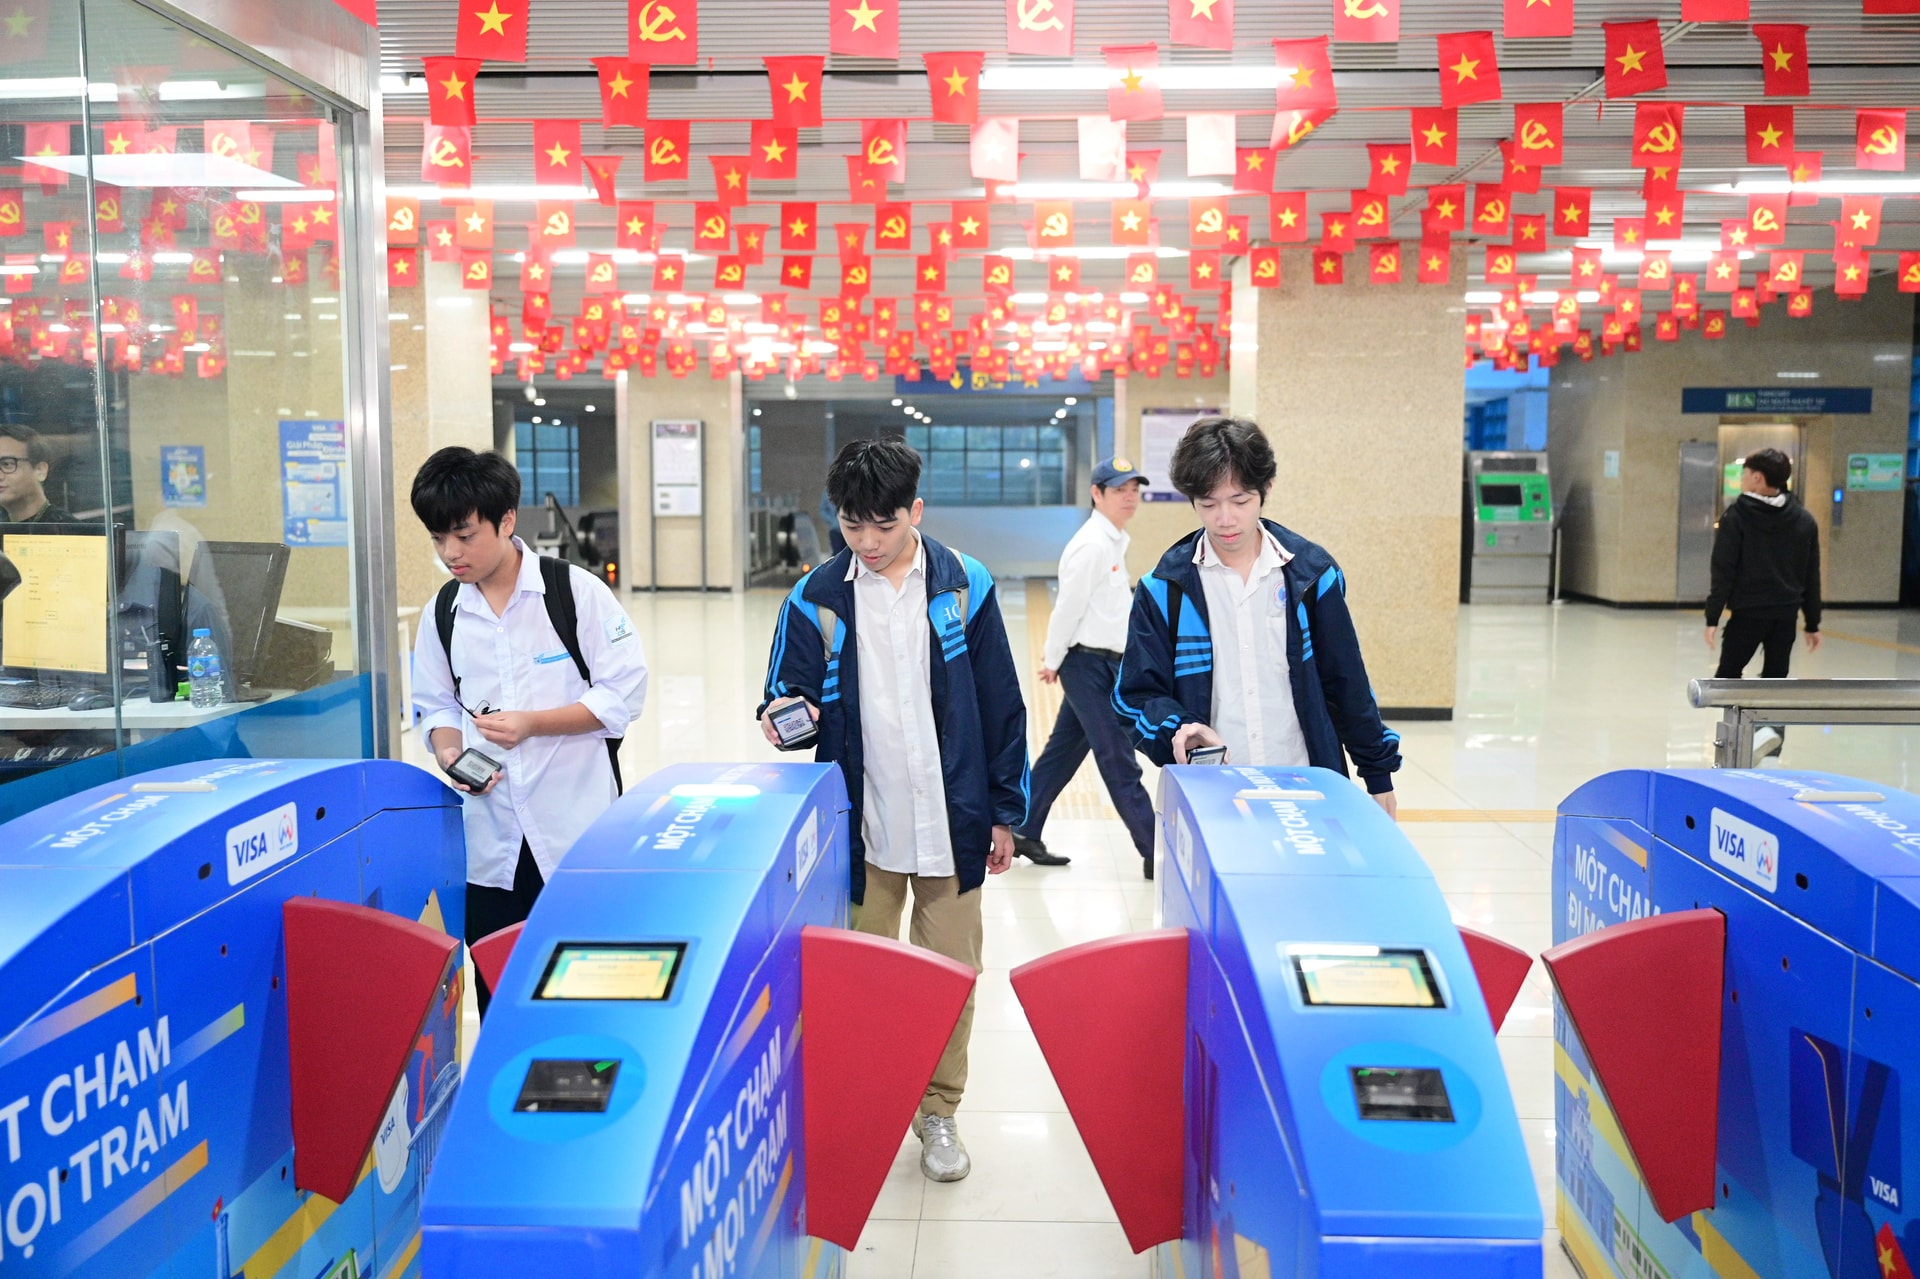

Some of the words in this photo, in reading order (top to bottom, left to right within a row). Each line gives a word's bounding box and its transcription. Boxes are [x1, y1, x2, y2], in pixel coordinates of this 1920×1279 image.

[50, 822, 112, 849] MỘT
[100, 795, 170, 822] CHẠM
[1269, 801, 1309, 828] CHẠM
[1836, 804, 1909, 831] CHẠM
[233, 832, 268, 867] VISA
[653, 823, 696, 850] MỘT
[1284, 828, 1326, 855] MỘT
[1715, 824, 1745, 862] VISA
[1575, 843, 1607, 901] MỘT
[1568, 891, 1582, 935] ĐI
[41, 1015, 171, 1137] CHẠM
[380, 1116, 396, 1146] VISA
[680, 1111, 734, 1248] MỘT
[734, 1024, 782, 1151] CHẠM
[0, 1165, 62, 1260] ỌI
[69, 1080, 190, 1204] TRẠM
[703, 1180, 746, 1279] MỌI
[746, 1090, 788, 1217] TRẠM
[1868, 1174, 1898, 1208] VISA
